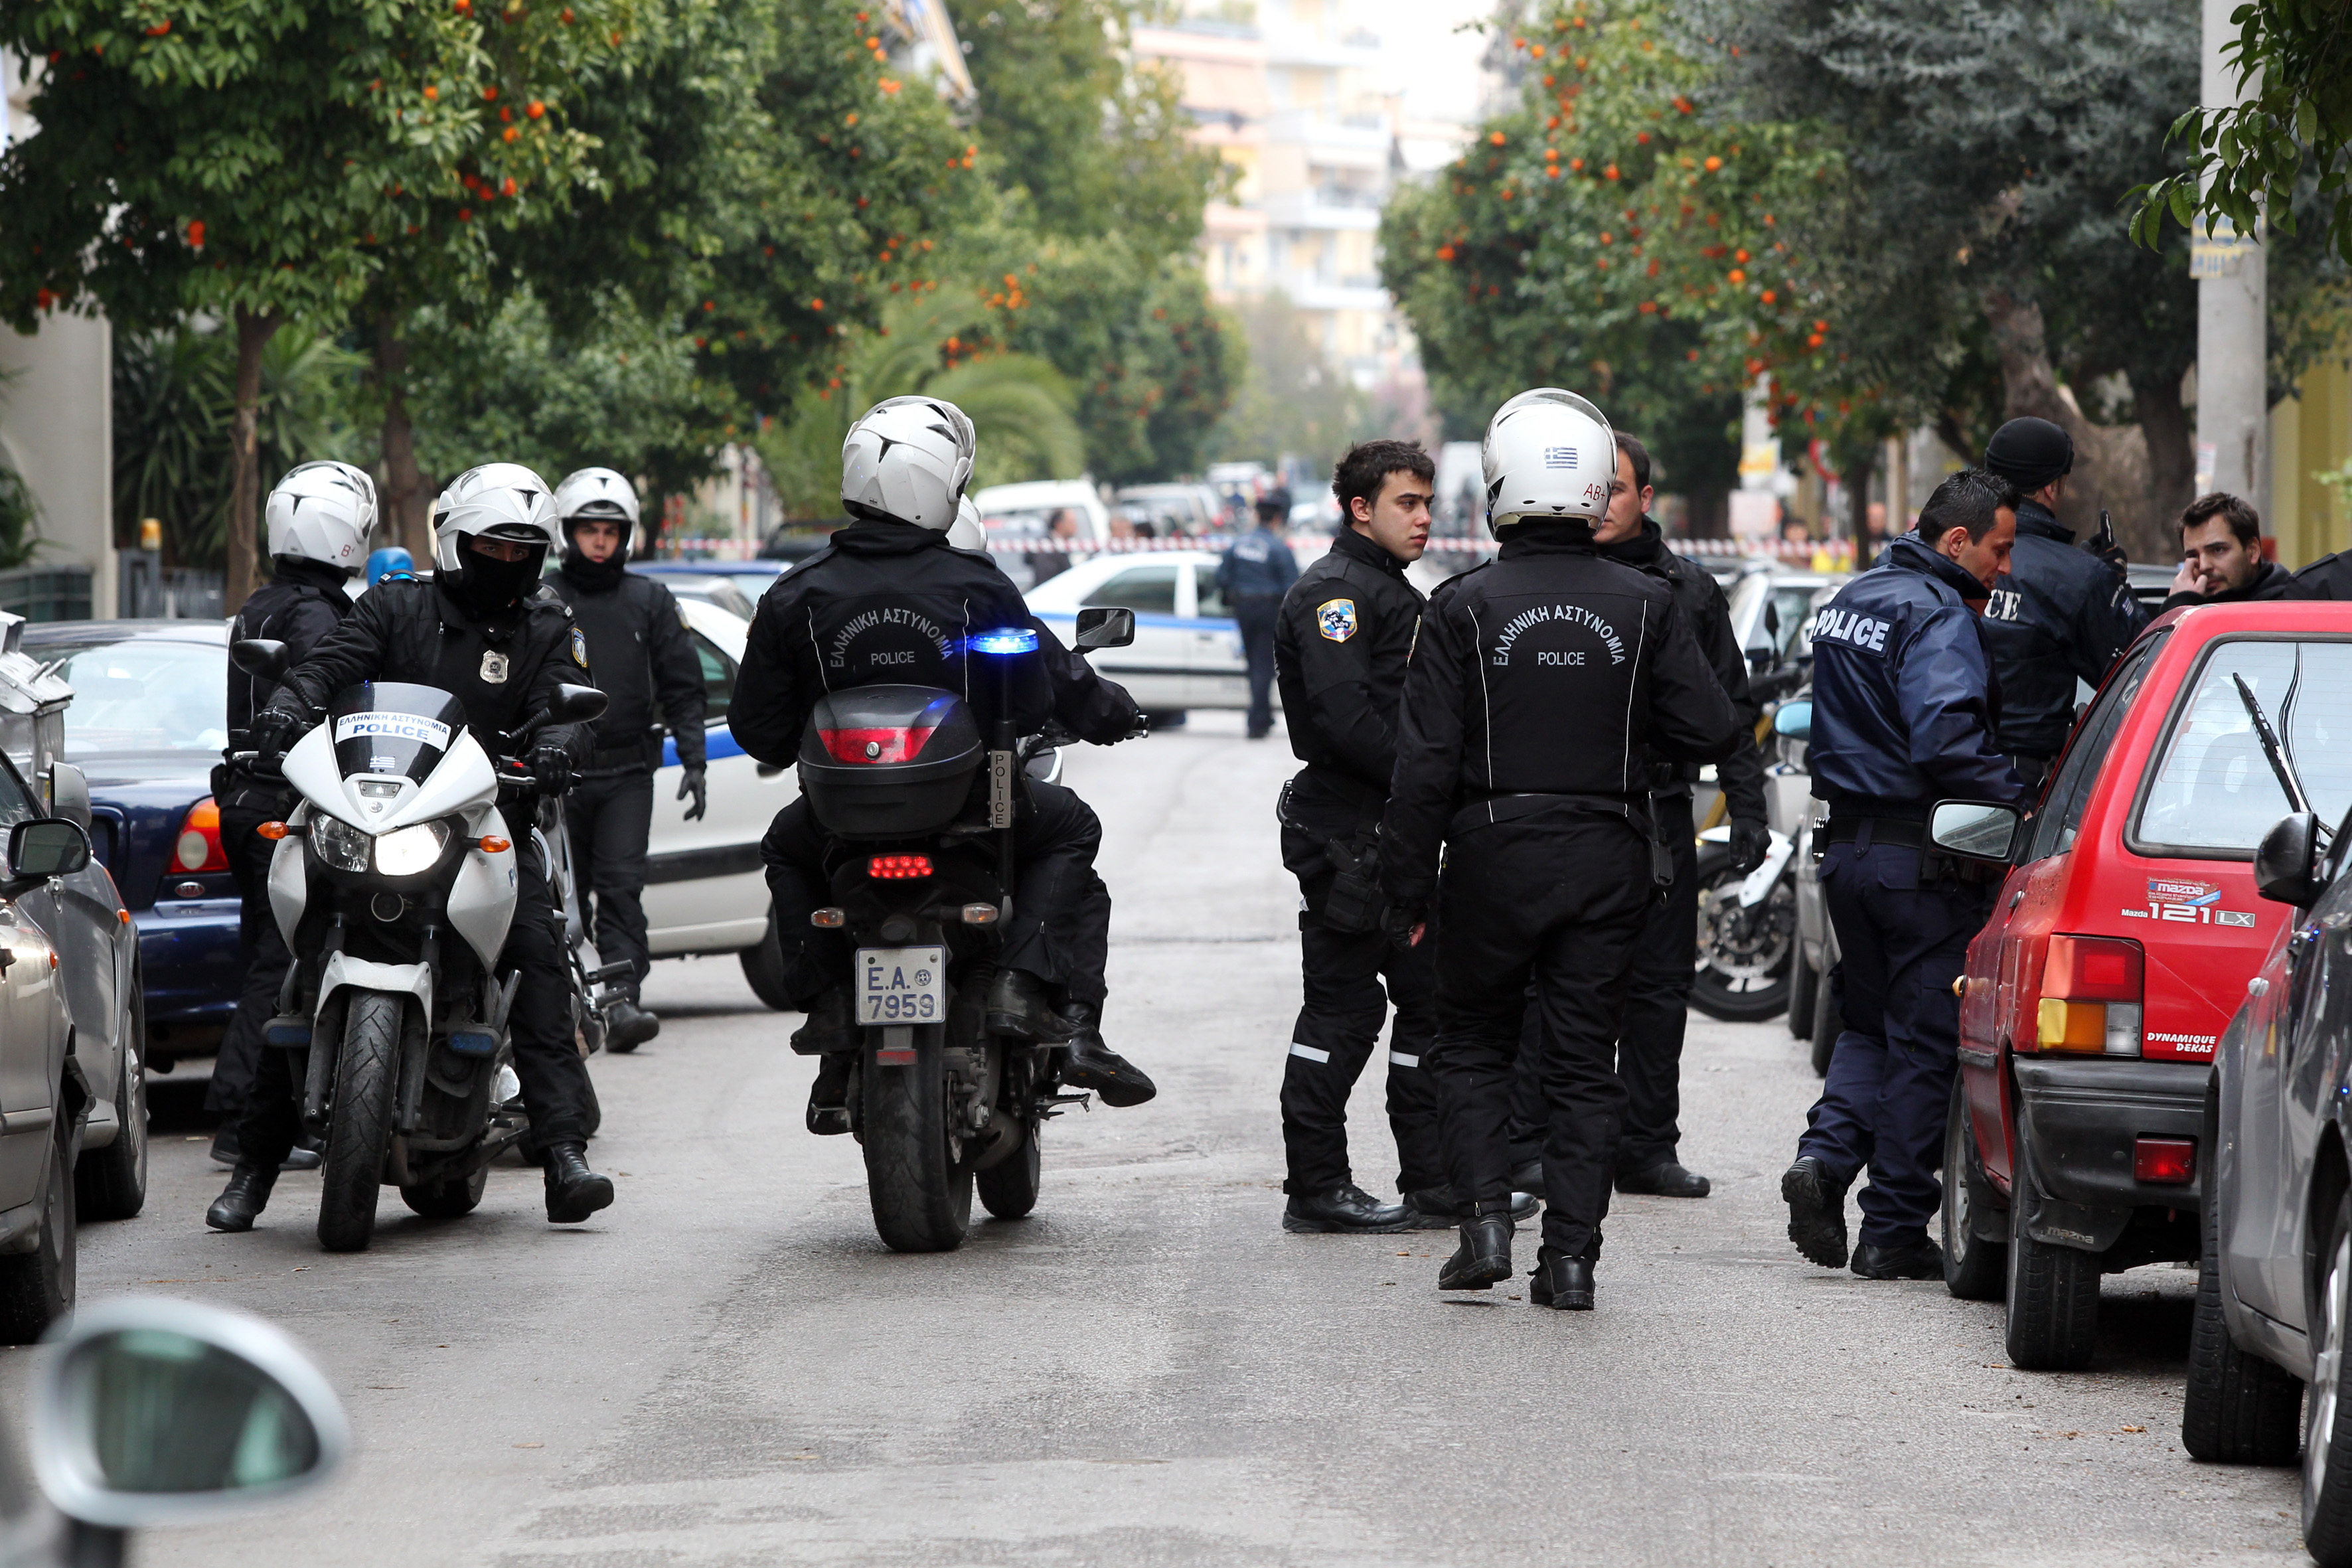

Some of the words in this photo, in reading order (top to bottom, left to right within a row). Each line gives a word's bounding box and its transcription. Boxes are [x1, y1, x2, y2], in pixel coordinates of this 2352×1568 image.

[1583, 483, 1606, 501] AB+
[830, 610, 880, 667] ΕΛΛΗΝΙΚΗ
[883, 607, 954, 661] ΑΣΤΥΝΟΜΙΑ
[1493, 605, 1550, 666] ΕΛΛΗΝΙΚΗ
[1553, 604, 1626, 665] ΑΣΤΥΝΟΜΙΑ
[1813, 608, 1891, 652] POLICE
[870, 651, 915, 665] POLICE
[1537, 651, 1585, 666] POLICE
[339, 714, 388, 726] ΕΛΛΗΝΙΚΗ
[390, 714, 447, 735] ΑΣΤΥΝΟΜΙΑ
[353, 724, 430, 740] POLICE
[995, 754, 1005, 824] POLICE
[2121, 908, 2149, 918] Mazda
[2148, 902, 2211, 924] 121
[2219, 912, 2251, 926] LX
[868, 993, 935, 1019] 7959
[2146, 1032, 2217, 1044] DYNAMIQUE
[2175, 1043, 2213, 1053] DEKAS
